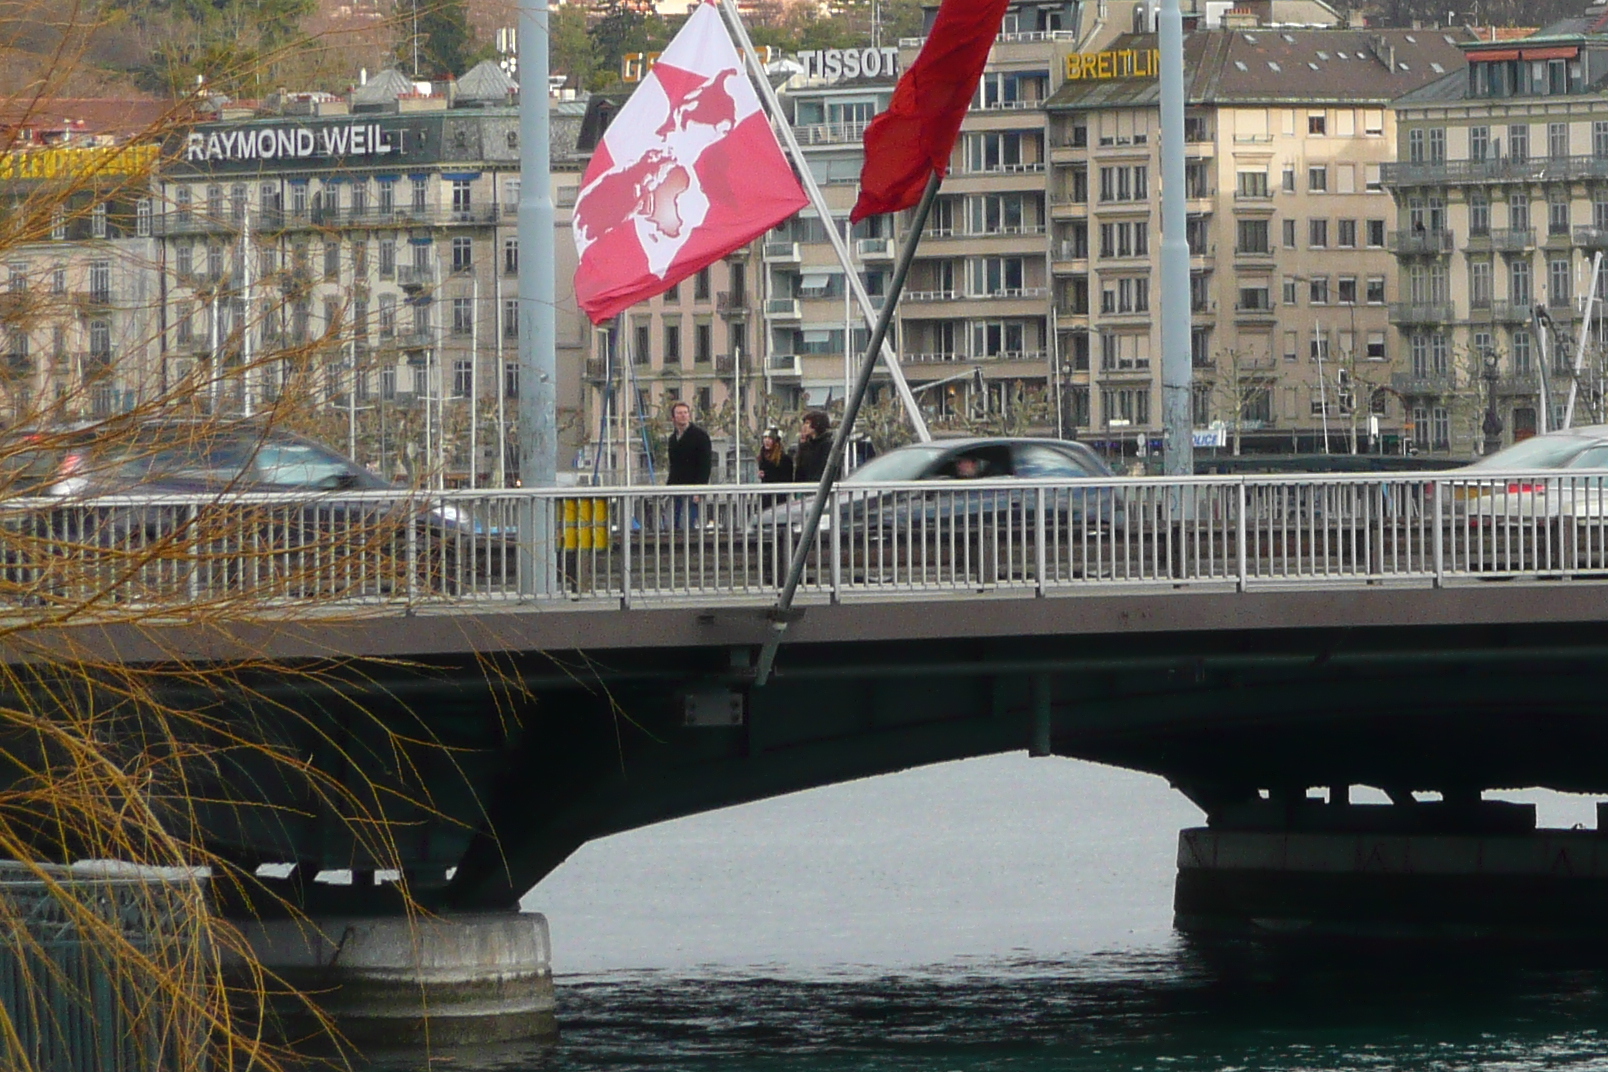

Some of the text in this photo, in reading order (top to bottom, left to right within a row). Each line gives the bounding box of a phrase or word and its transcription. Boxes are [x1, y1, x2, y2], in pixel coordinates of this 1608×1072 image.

[798, 46, 898, 79] TISSOT
[1066, 48, 1161, 79] BREITLIN
[187, 124, 391, 161] RAYMOND WEIL
[1192, 434, 1217, 446] OLICE
